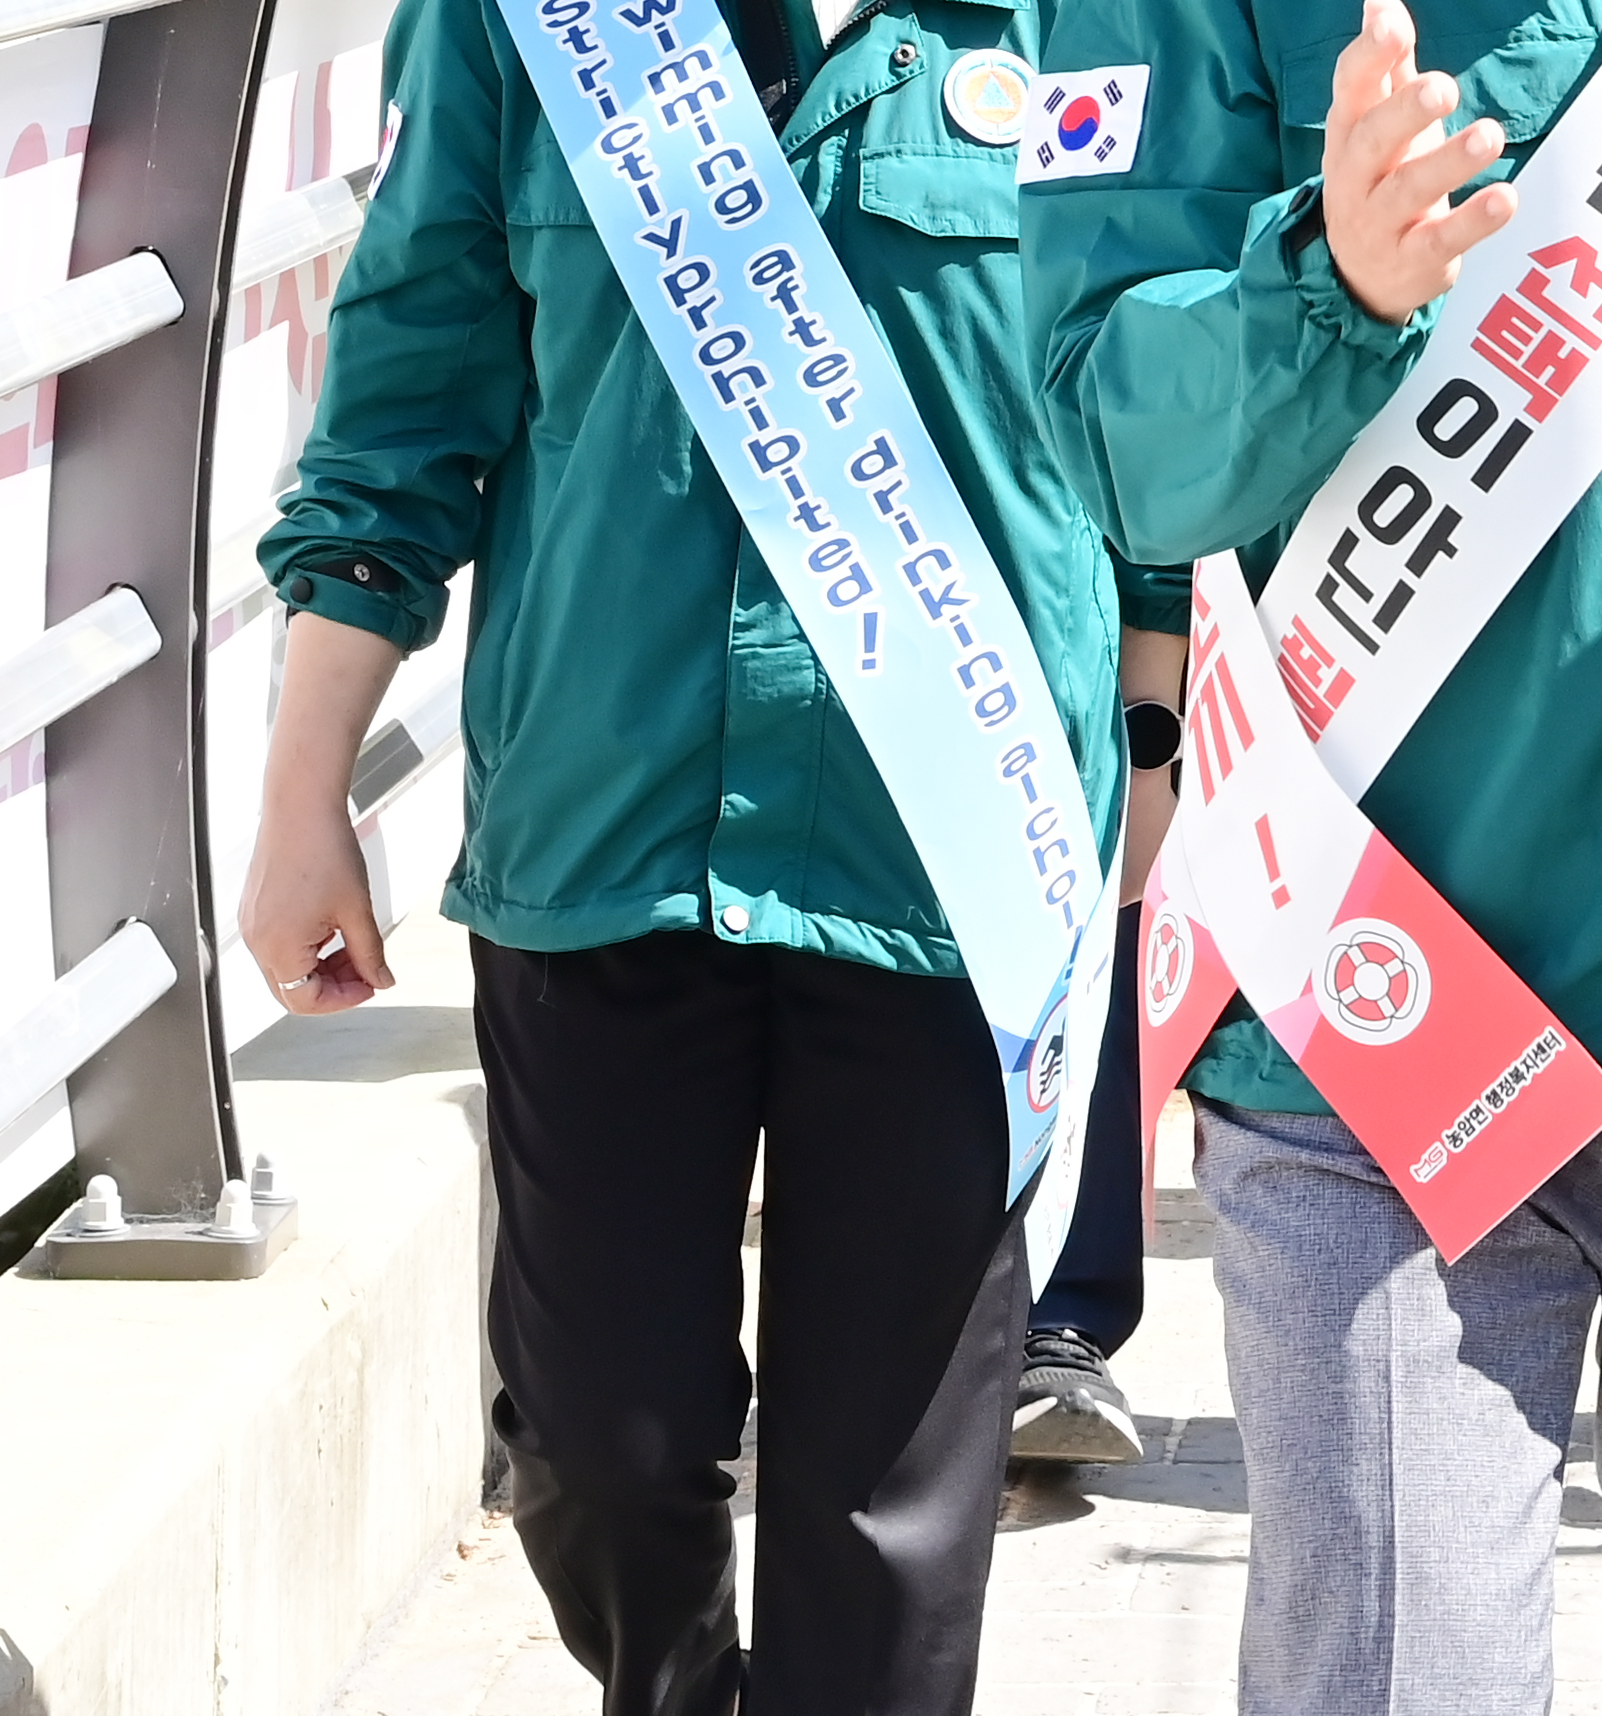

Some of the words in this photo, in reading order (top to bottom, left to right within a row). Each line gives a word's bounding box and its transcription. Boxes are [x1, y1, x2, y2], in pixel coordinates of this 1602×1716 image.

[750, 248, 857, 424] after
[851, 435, 1017, 728] drinking
[1313, 466, 1464, 656] 아닌
[1444, 1104, 1490, 1150] 농암면
[1483, 1030, 1563, 1112] 행정복지센터
